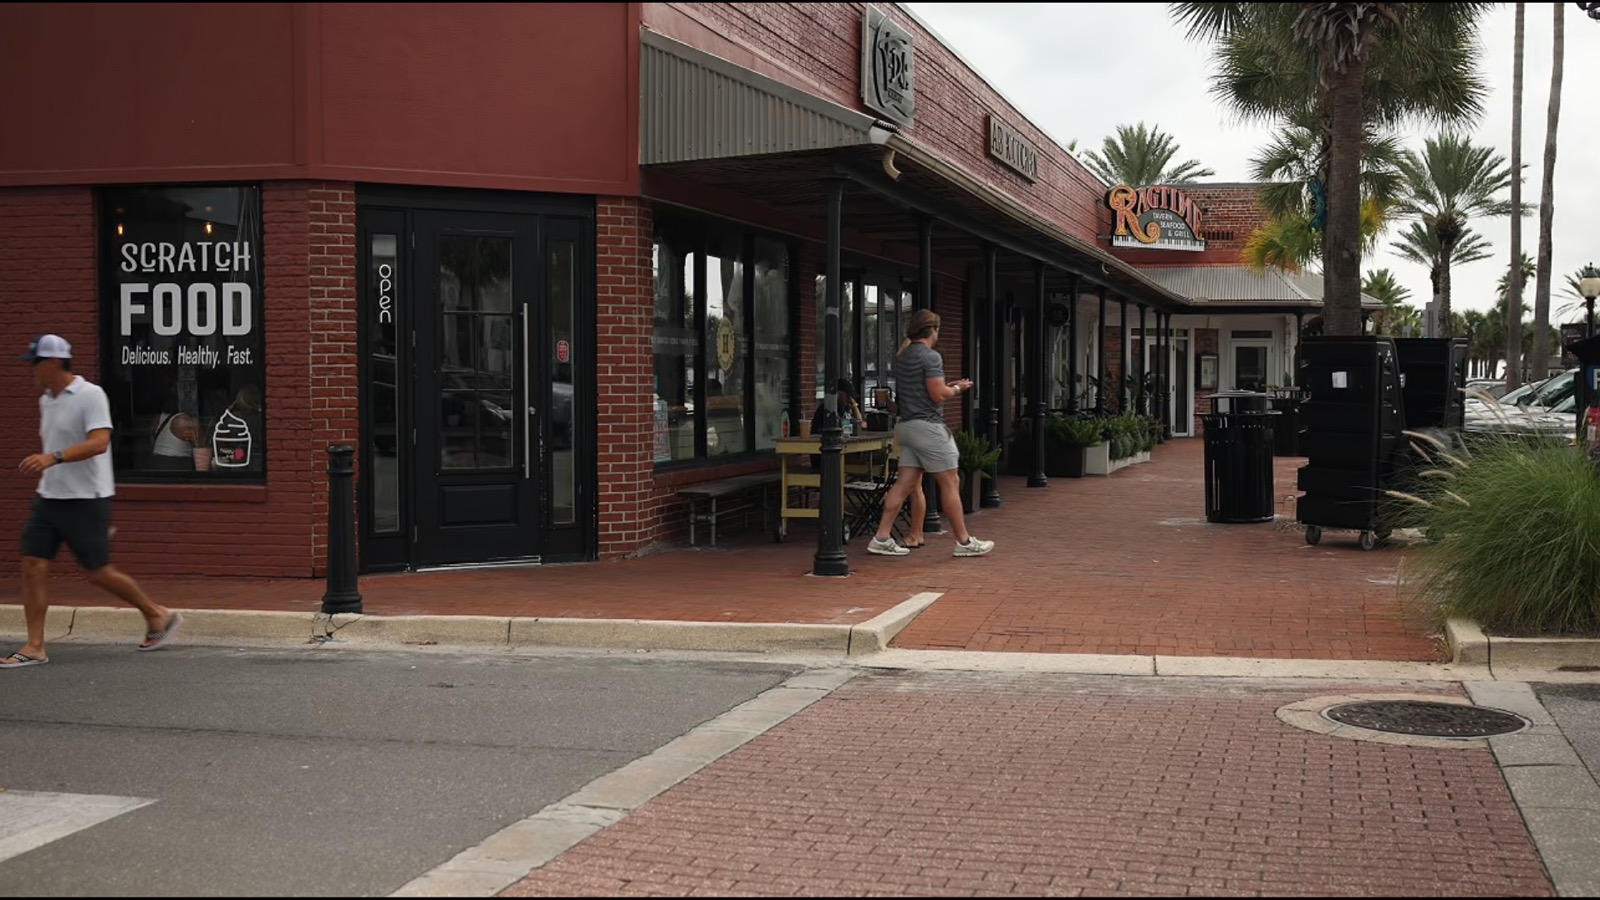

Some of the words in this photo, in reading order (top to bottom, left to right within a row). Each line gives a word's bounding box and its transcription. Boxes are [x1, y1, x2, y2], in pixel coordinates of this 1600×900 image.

[992, 122, 1004, 155] AB
[1109, 184, 1204, 244] RAGTIME
[1152, 212, 1173, 220] TAVERN
[1160, 221, 1185, 229] SEAFOOD
[1174, 230, 1190, 238] GRILL
[121, 241, 251, 273] SCRATCH
[120, 282, 252, 336] FOOD
[121, 345, 172, 365] Delicious.
[177, 345, 220, 369] Healthy.
[226, 345, 253, 365] Fast.
